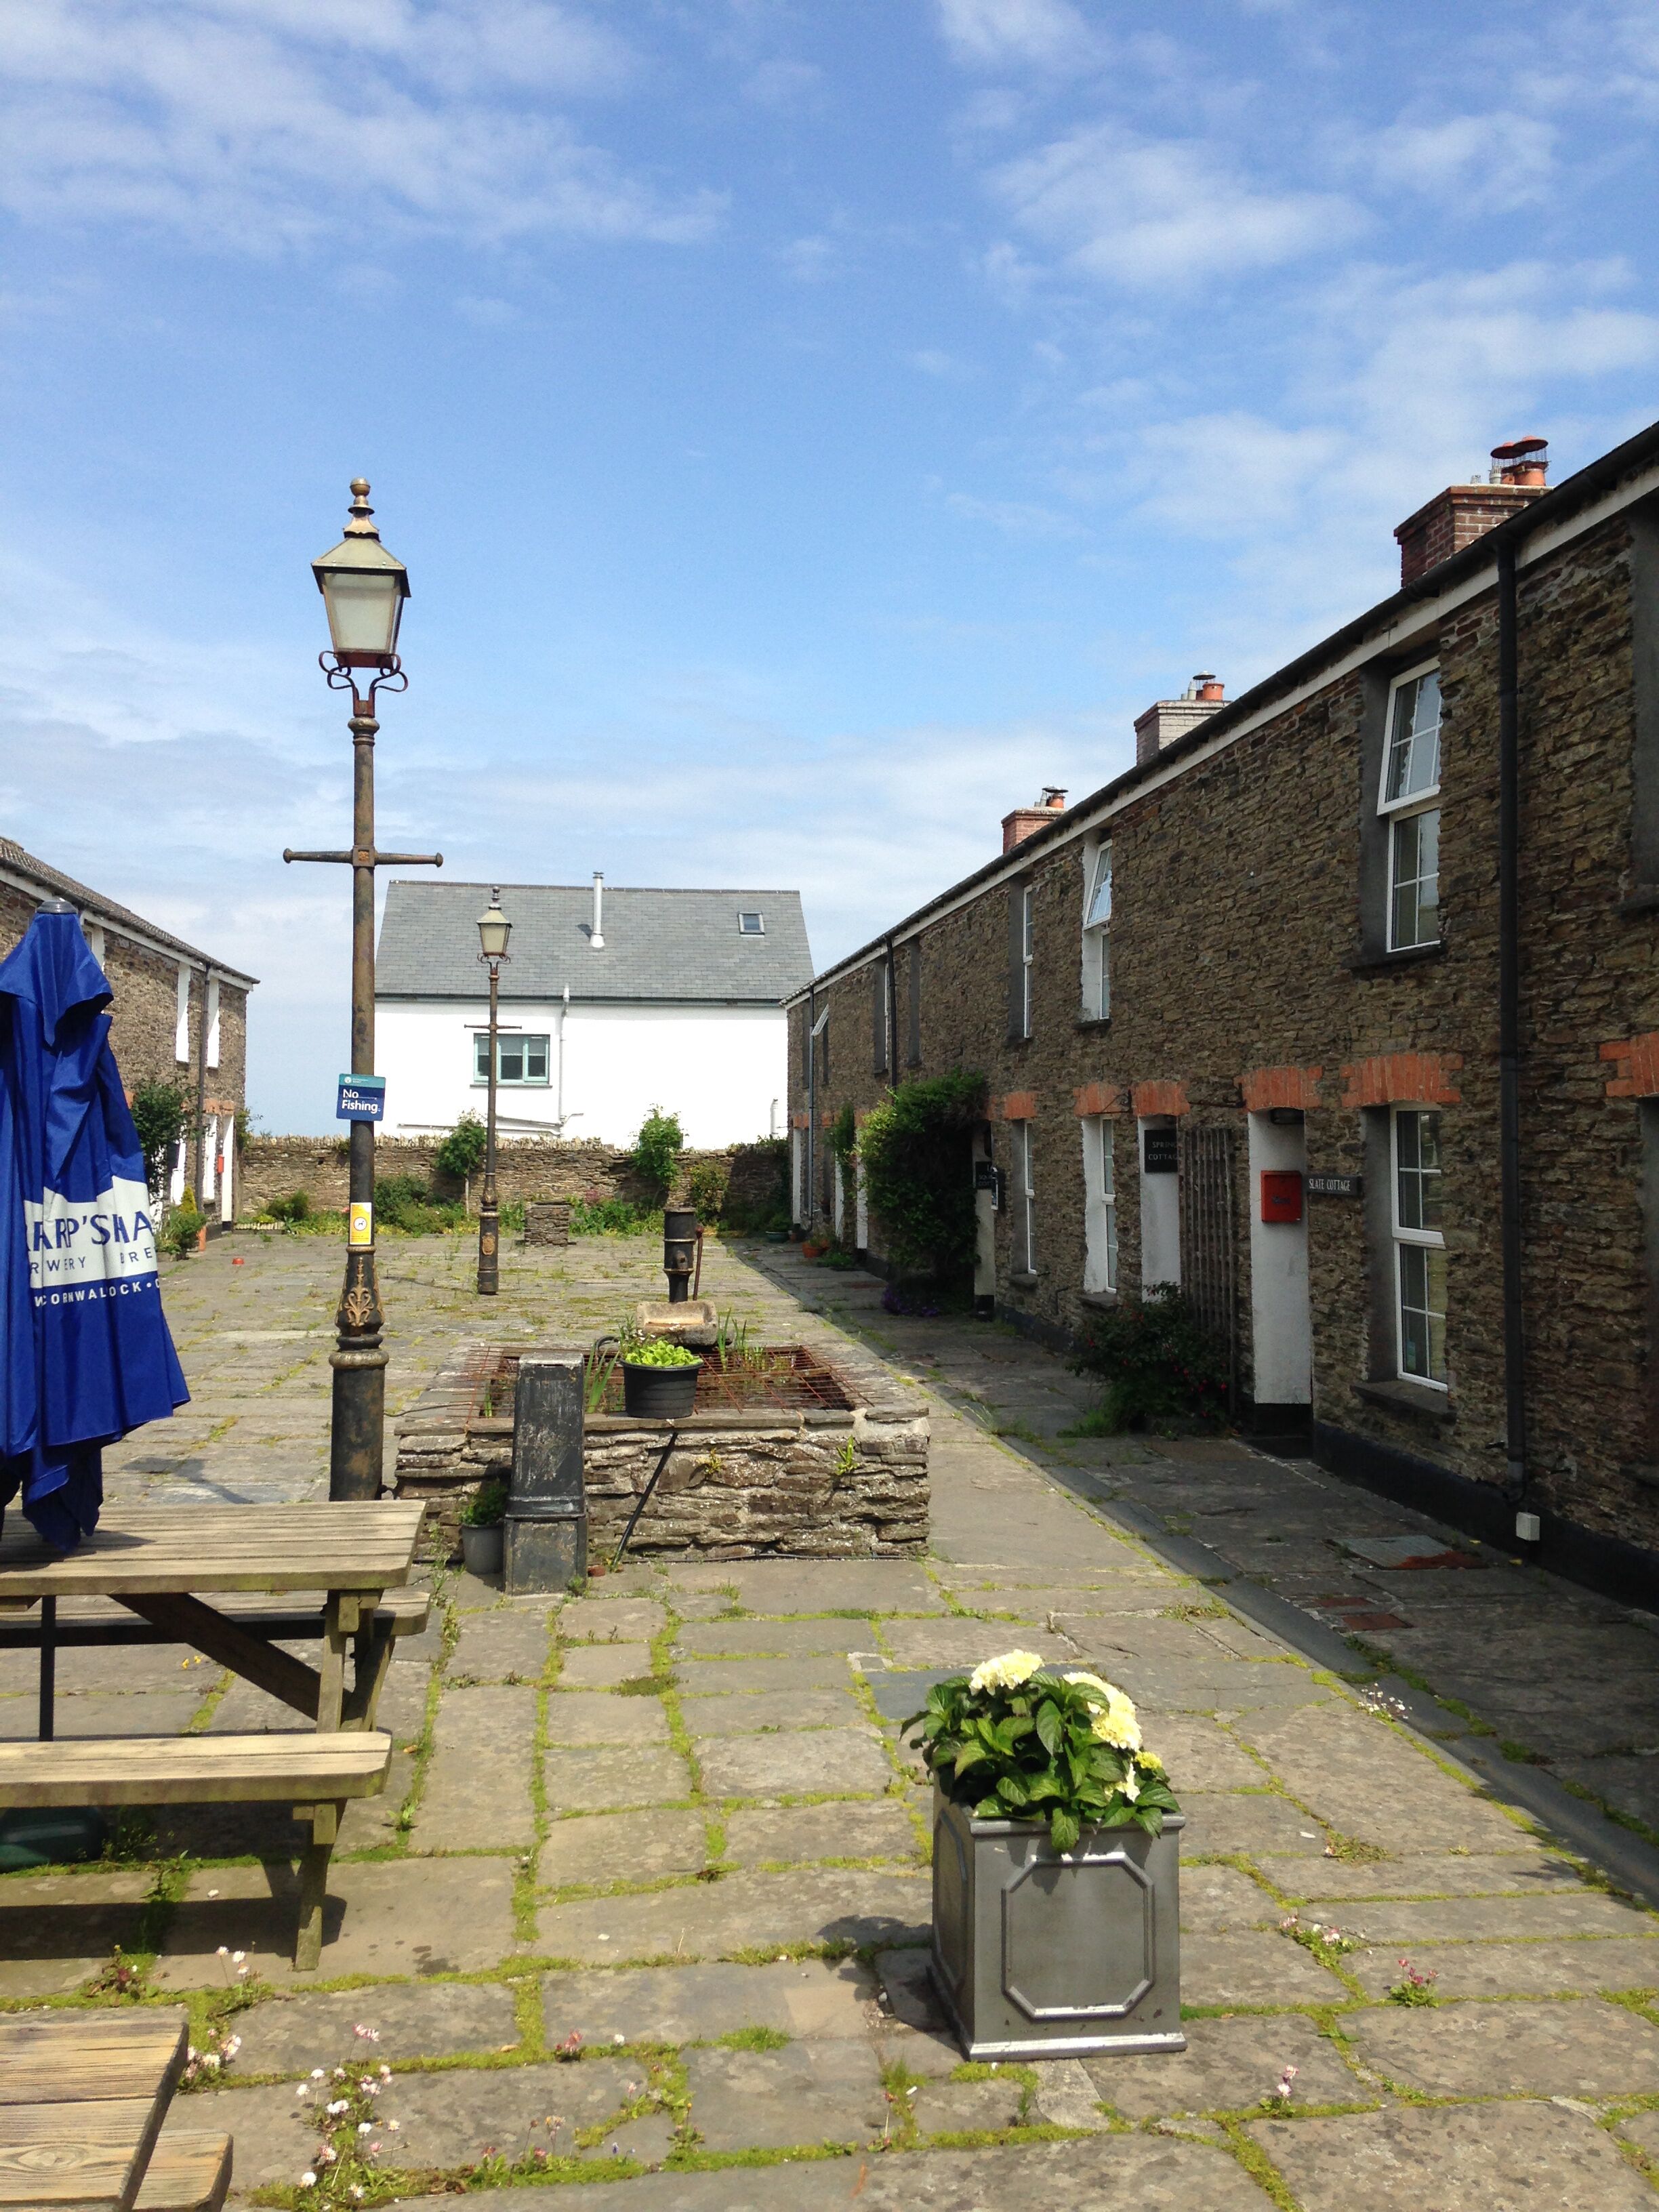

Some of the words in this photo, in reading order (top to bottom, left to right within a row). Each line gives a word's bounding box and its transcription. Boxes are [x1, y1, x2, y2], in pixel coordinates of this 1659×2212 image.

[342, 1088, 359, 1099] No
[342, 1099, 378, 1114] Fishing
[1309, 1178, 1324, 1190] SLATE
[1326, 1179, 1351, 1191] COTTAGE
